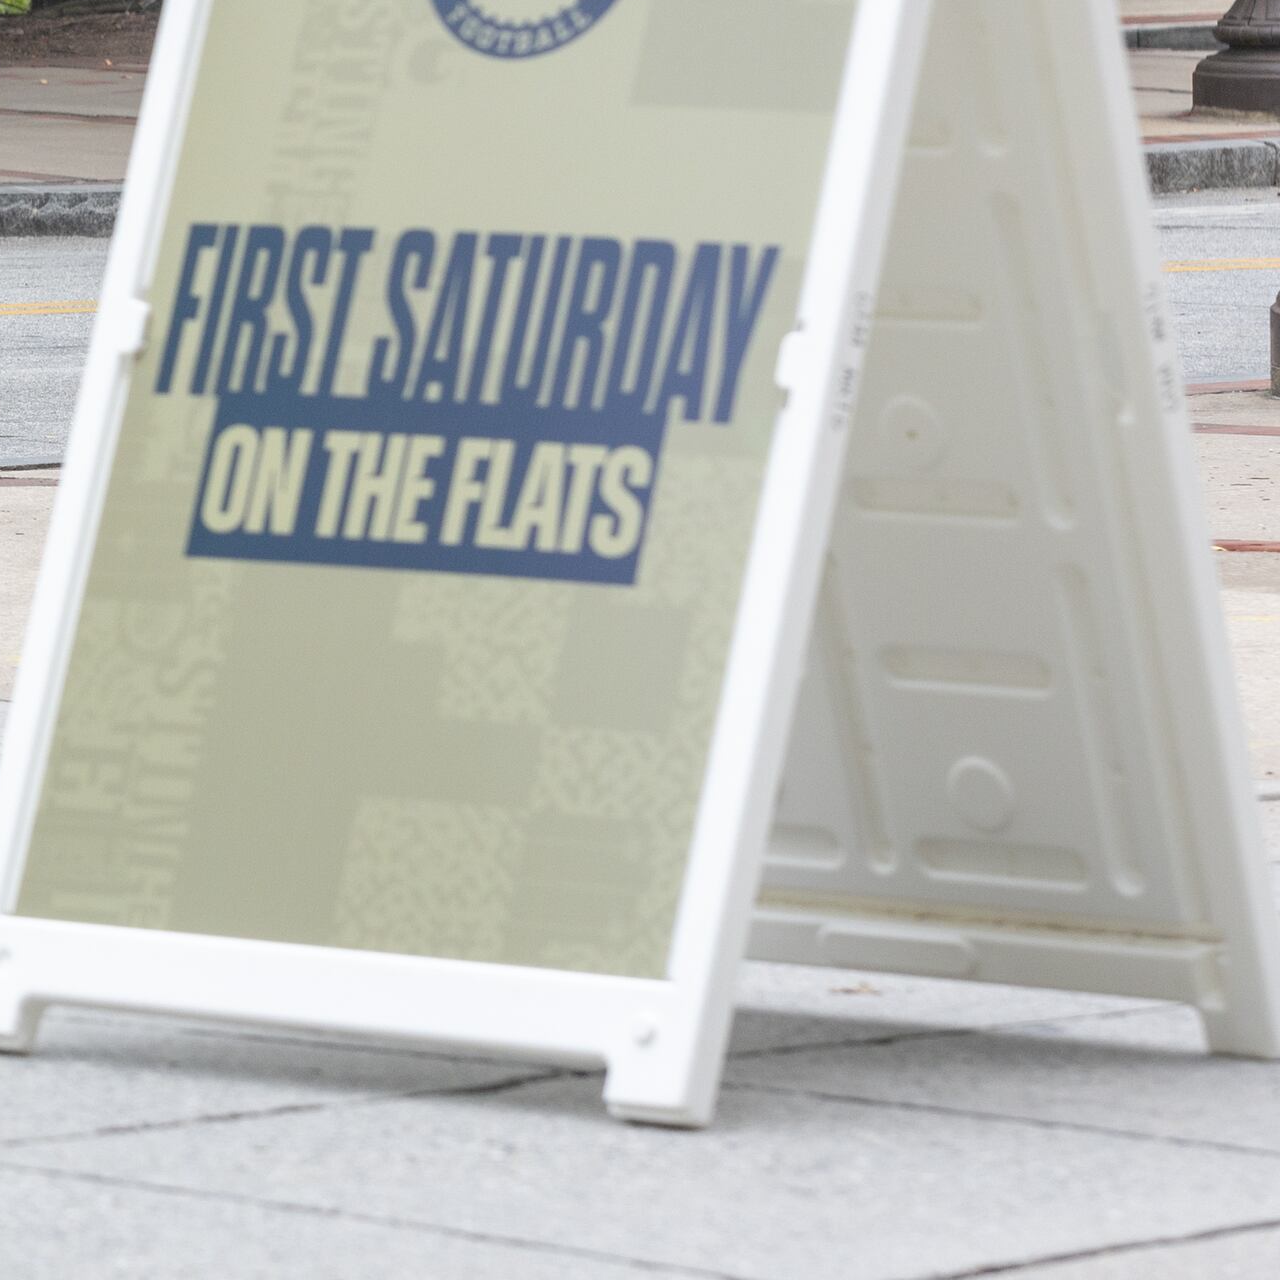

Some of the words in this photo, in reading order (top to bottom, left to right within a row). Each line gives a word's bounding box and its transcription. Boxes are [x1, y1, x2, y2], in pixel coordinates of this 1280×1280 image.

[153, 223, 377, 398] FIRST
[362, 227, 782, 425] SATURDAY
[200, 424, 313, 536] ON
[314, 429, 445, 545] THE
[439, 435, 653, 560] FLATS
